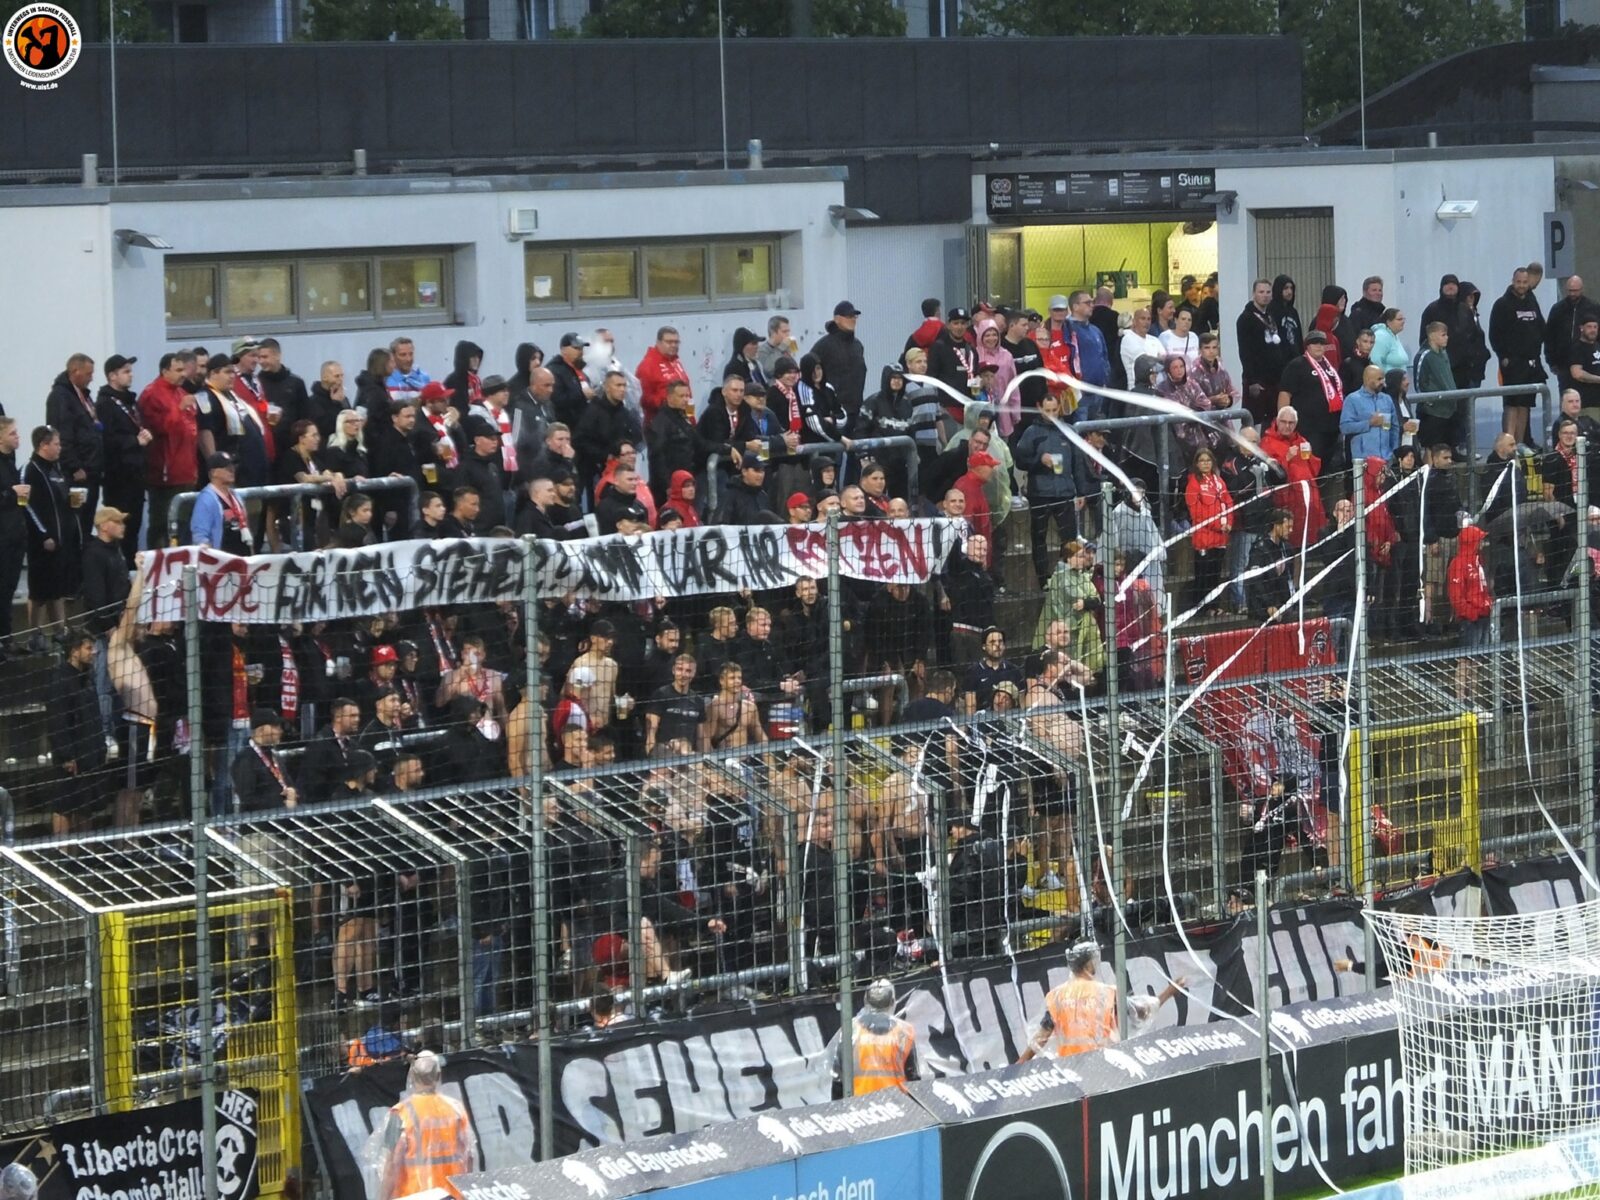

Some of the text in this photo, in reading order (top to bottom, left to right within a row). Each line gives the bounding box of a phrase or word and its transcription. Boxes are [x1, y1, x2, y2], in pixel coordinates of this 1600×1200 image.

[1550, 220, 1566, 269] P
[1302, 997, 1405, 1028] die Bayerische
[1133, 1045, 1167, 1066] die
[221, 1090, 253, 1124] HFC
[963, 1083, 998, 1103] die
[1100, 1019, 1573, 1200] München fährt MAN
[789, 1099, 905, 1139] die Bayerische
[158, 1126, 206, 1164] Cre
[599, 1140, 728, 1181] die Bayerische
[158, 1167, 206, 1200] Hall
[834, 1176, 875, 1200] dem
